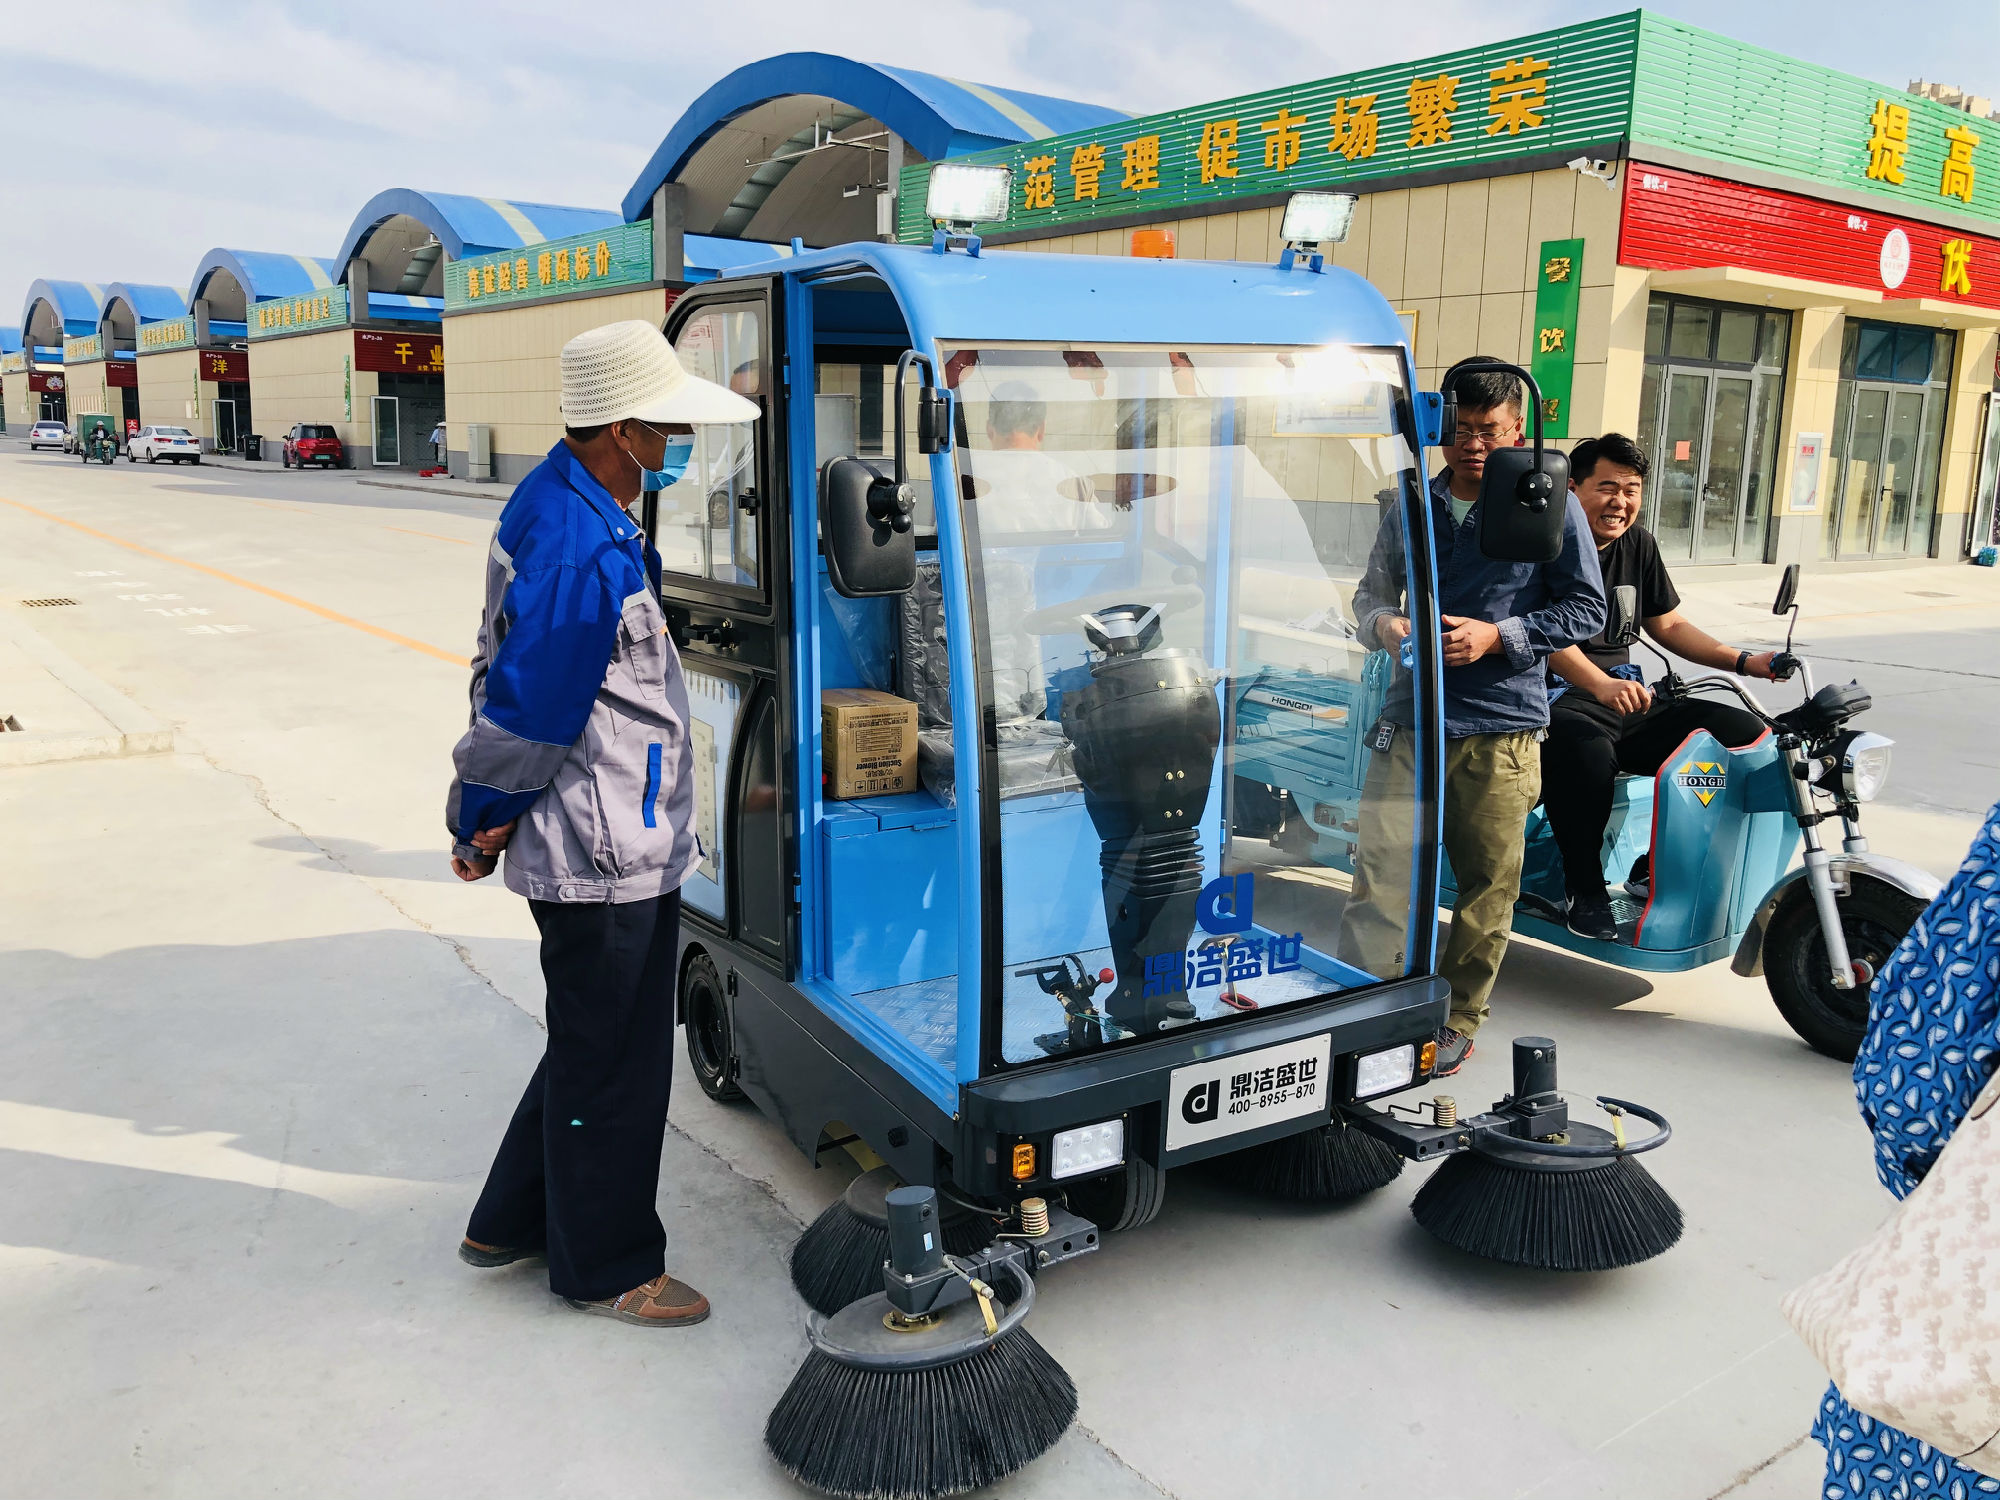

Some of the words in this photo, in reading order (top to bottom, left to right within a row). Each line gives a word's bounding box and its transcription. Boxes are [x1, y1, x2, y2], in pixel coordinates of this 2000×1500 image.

[996, 134, 1160, 211] 范管理
[1197, 57, 1551, 184] 促市场繁荣
[1867, 98, 1980, 203] 提高
[538, 240, 611, 285] 明码标价
[212, 359, 228, 374] 洋
[855, 761, 879, 770] Blower
[879, 759, 903, 769] Suction
[1143, 931, 1304, 999] 鼎洁盛世
[1228, 1082, 1316, 1116] 400-8955-870
[1229, 1056, 1318, 1100] 鼎洁盛世
